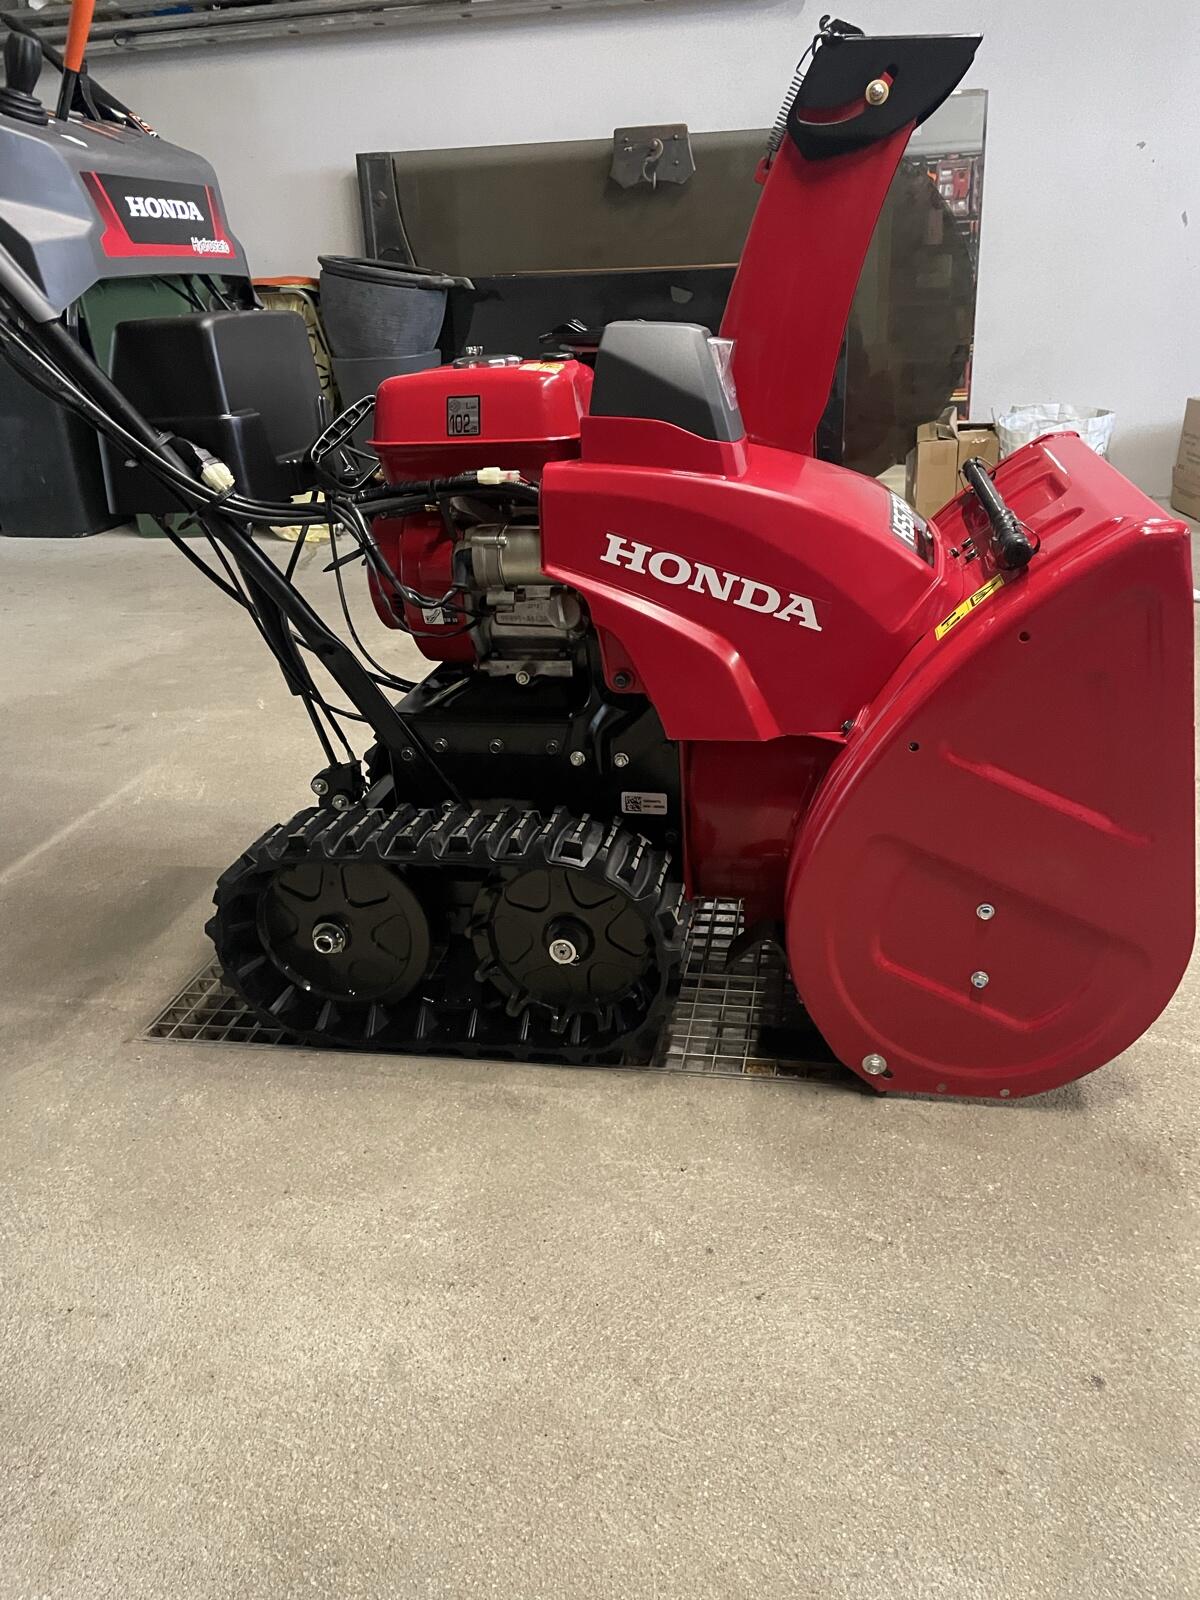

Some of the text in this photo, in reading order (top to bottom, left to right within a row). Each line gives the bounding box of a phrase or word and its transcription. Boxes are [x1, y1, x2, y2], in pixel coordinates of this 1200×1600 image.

[125, 196, 204, 221] HONDA
[449, 413, 470, 433] 102
[600, 533, 823, 632] HONDA
